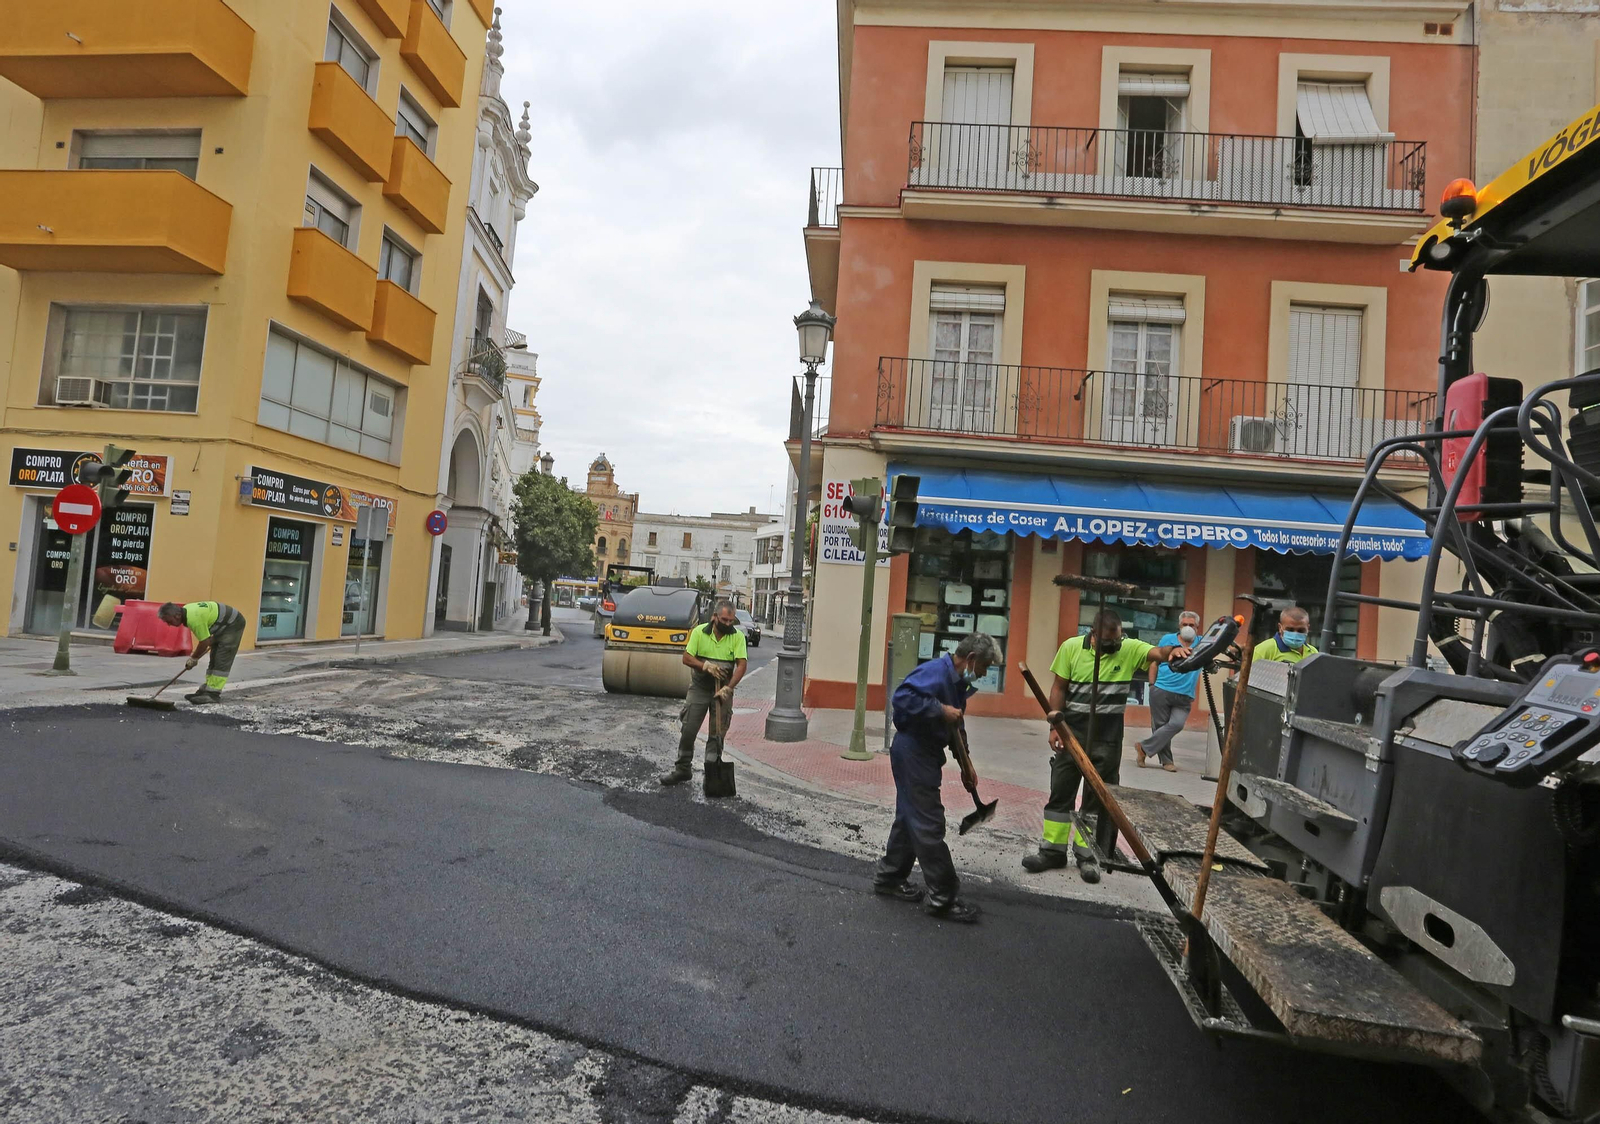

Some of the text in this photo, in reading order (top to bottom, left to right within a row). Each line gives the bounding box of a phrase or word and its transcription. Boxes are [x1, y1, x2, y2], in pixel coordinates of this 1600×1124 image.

[25, 454, 62, 468] COMPRO
[18, 468, 65, 483] ORO/PLATA
[127, 469, 154, 483] RO
[257, 474, 284, 489] COMPRO
[252, 487, 286, 504] ORO/PLATA
[827, 482, 844, 500] SE
[115, 511, 147, 523] COMPRO
[605, 511, 613, 521] R
[987, 511, 1005, 524] de
[1009, 512, 1048, 526] Coser
[110, 523, 150, 537] ORO/PLATA
[273, 527, 300, 540] COMPRO
[112, 537, 145, 549] No pierda
[824, 535, 839, 546] POR
[1279, 531, 1290, 545] los
[1291, 534, 1327, 547] accesorios
[46, 550, 71, 560] COMPRO
[268, 542, 301, 555] ORO/PLATA
[111, 551, 123, 560] sus
[51, 560, 64, 569] ORO
[110, 567, 134, 575] Invierta
[115, 574, 138, 585] ORO
